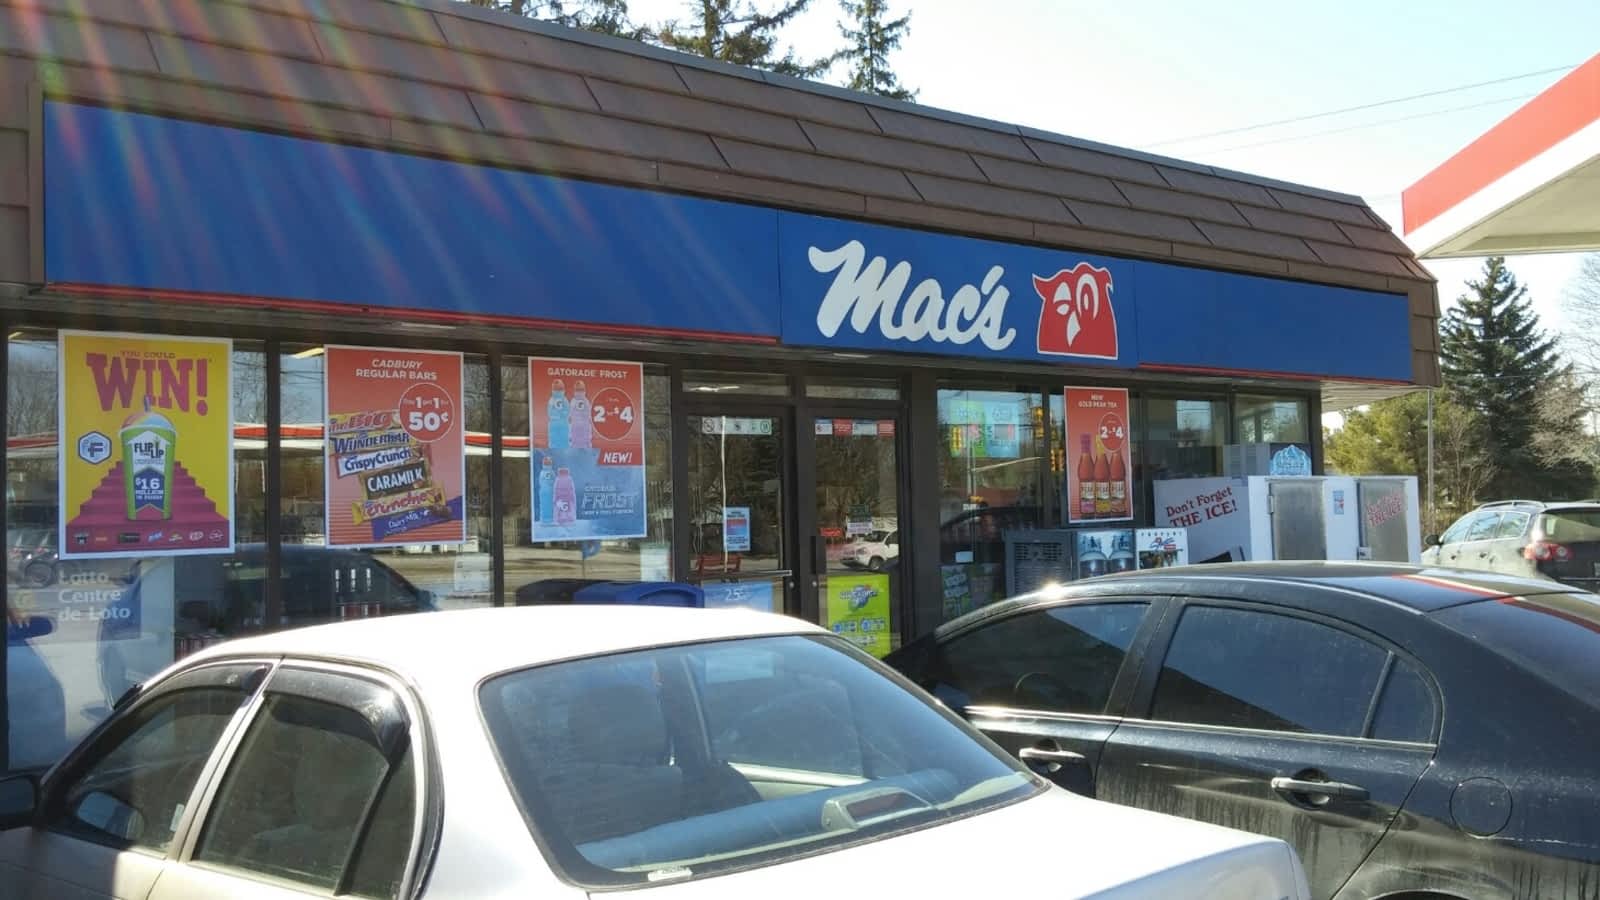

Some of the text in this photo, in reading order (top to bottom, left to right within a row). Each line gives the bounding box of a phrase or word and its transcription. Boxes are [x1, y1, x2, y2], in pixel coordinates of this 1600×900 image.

[808, 239, 1016, 351] Mac's
[144, 351, 176, 359] COULD
[372, 359, 423, 369] CADBURY
[356, 368, 437, 381] REGULAR BARS
[547, 367, 629, 379] GATORADE FROST
[86, 352, 208, 416] WIN!
[409, 411, 449, 432] 50¢
[603, 452, 633, 464] NEW!
[366, 467, 425, 493] CARAMILK
[1166, 486, 1233, 518] Don't Forget
[1169, 499, 1238, 528] THE ICE!
[58, 569, 110, 585] Lotto
[58, 588, 122, 604] Centre
[58, 605, 132, 622] de Loto
